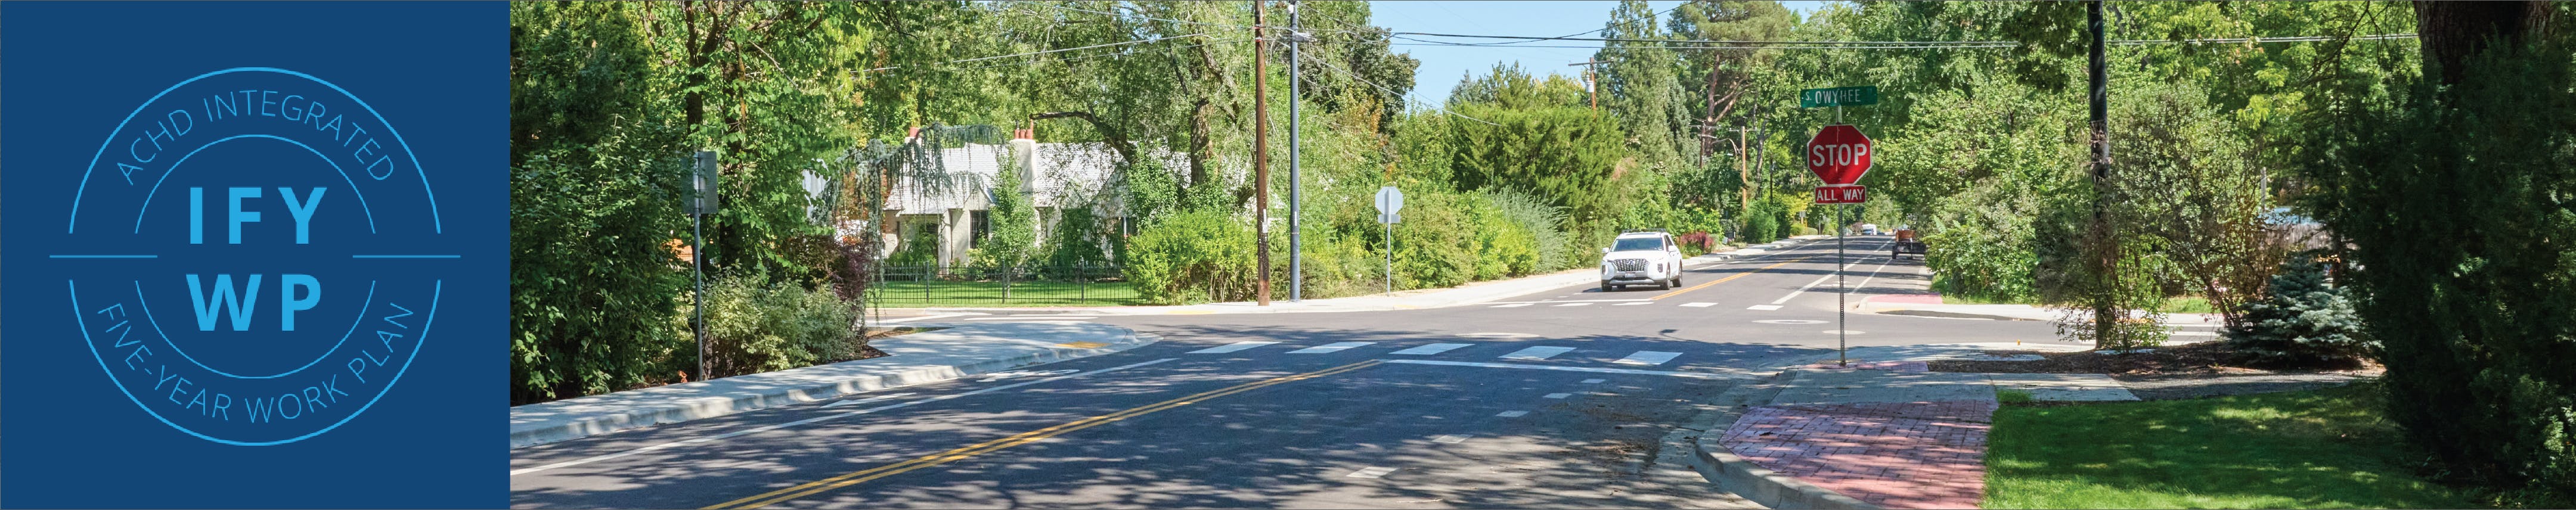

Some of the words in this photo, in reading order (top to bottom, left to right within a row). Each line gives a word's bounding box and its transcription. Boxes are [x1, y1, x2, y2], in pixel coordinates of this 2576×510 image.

[1815, 89, 1861, 104] OWYHEE
[1813, 144, 1867, 166] STOP
[1816, 191, 1838, 201] ALL
[1843, 189, 1864, 200] WAY
